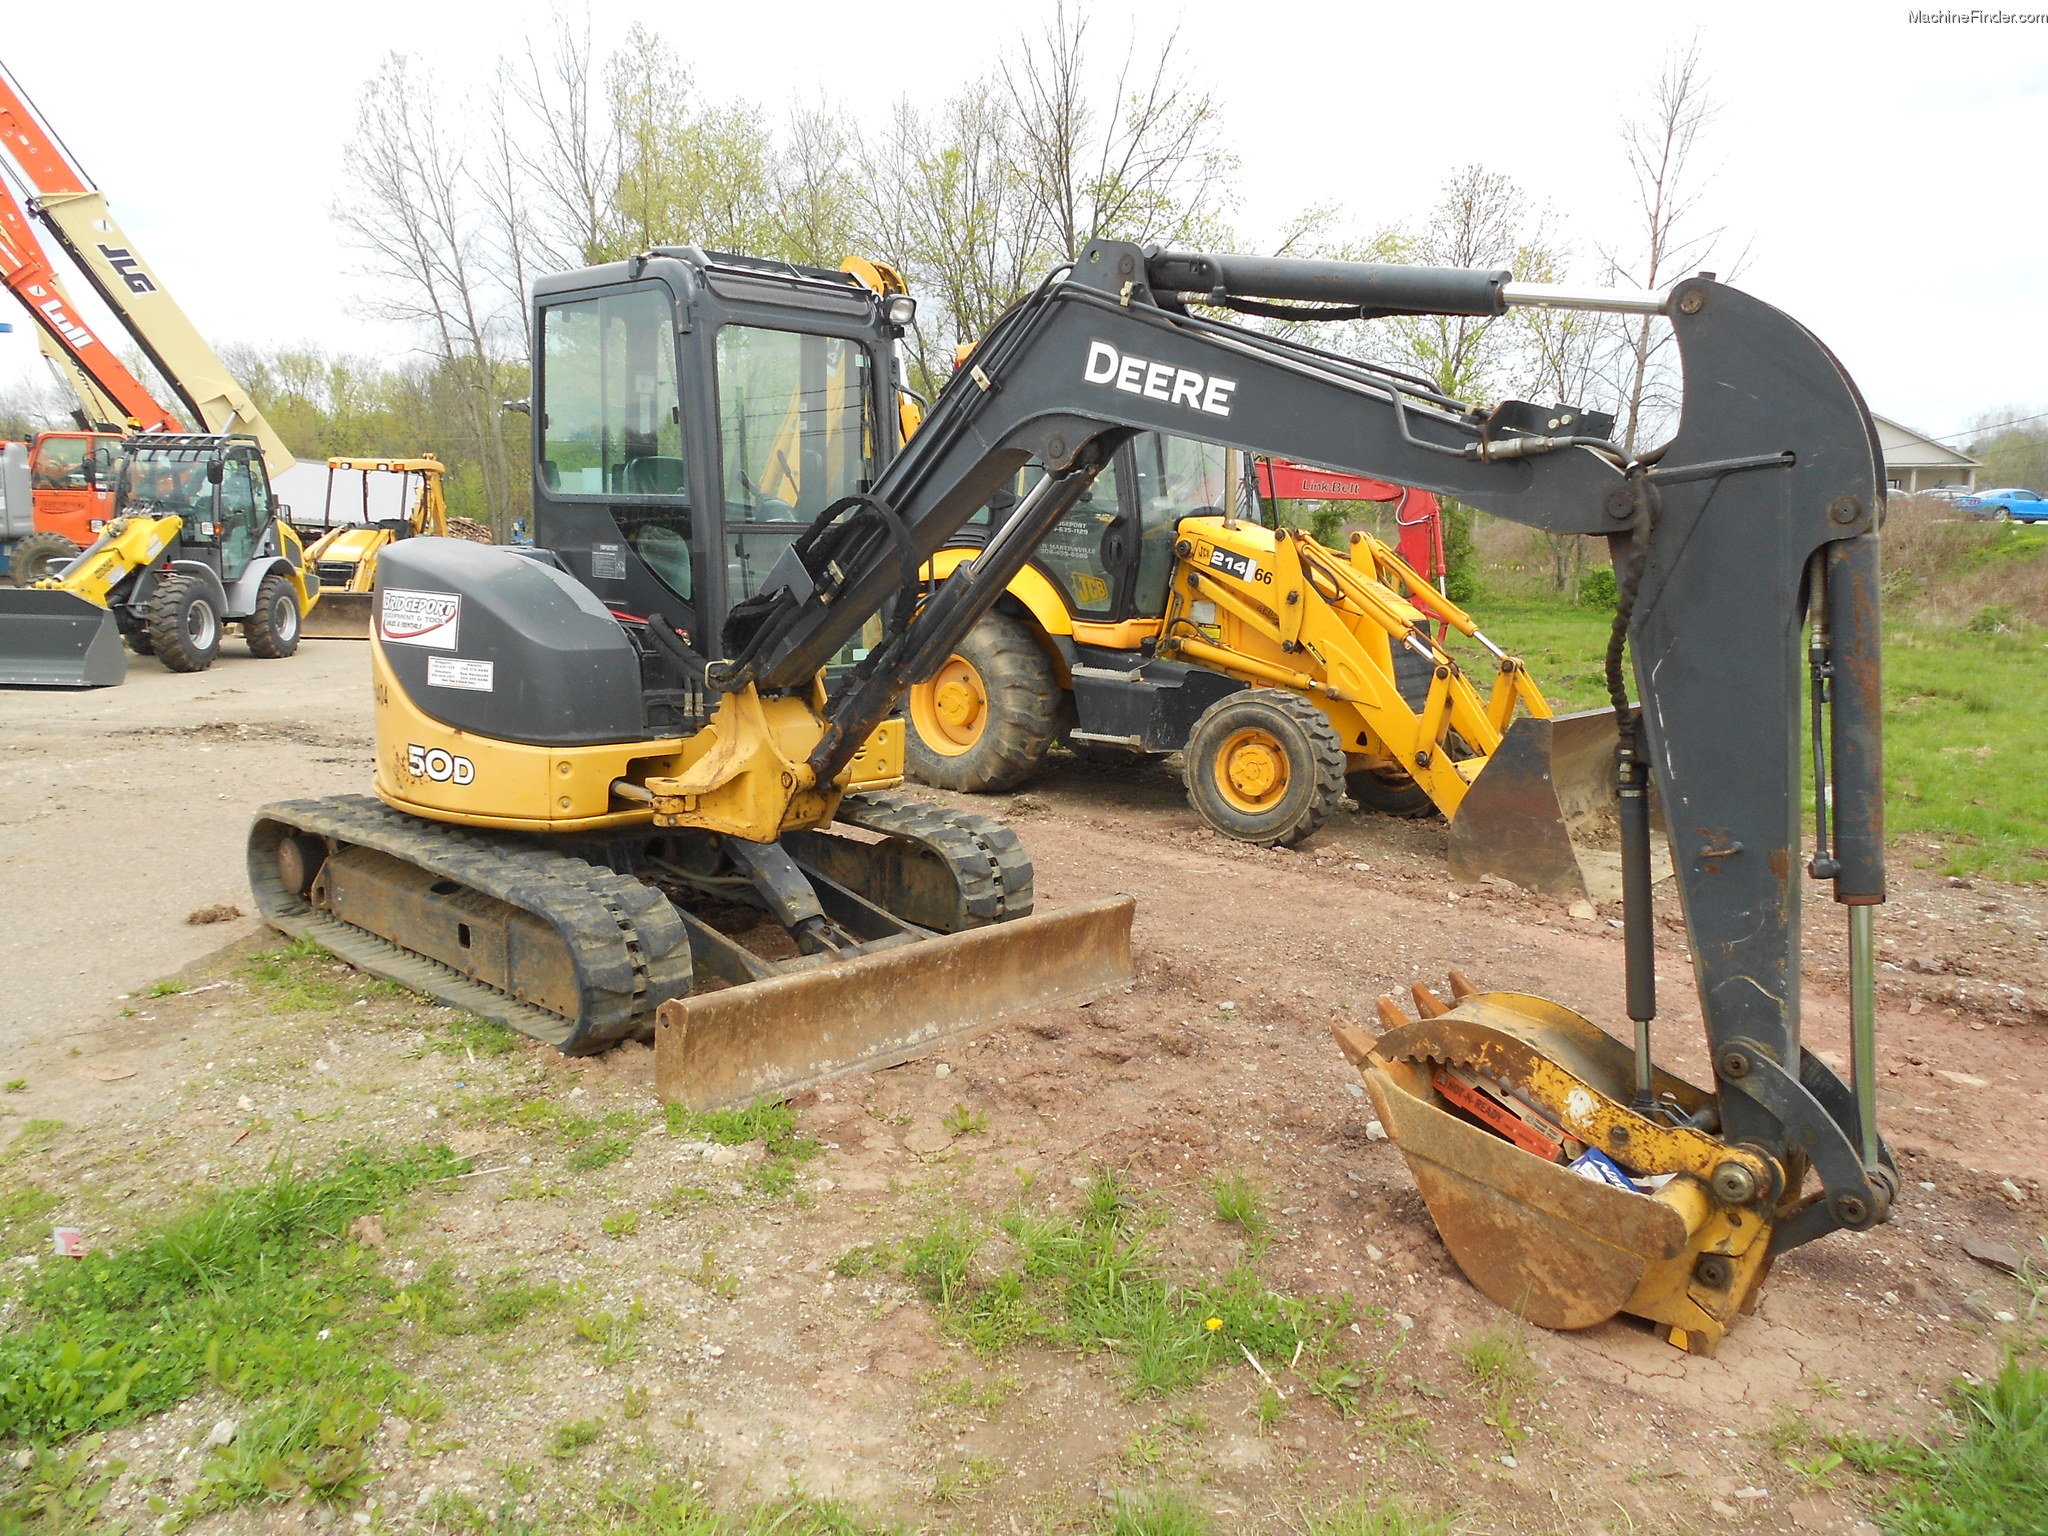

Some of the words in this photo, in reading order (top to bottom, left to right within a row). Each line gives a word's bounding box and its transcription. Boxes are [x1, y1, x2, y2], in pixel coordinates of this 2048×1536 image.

[97, 243, 158, 294] JLG
[1084, 341, 1236, 416] DEERE
[1302, 479, 1359, 494] Link-Belt
[1210, 550, 1247, 575] 214
[1076, 576, 1107, 602] JCB
[1254, 568, 1273, 585] 66
[383, 593, 457, 617] BRIDGEPORT
[407, 743, 475, 786] 50D
